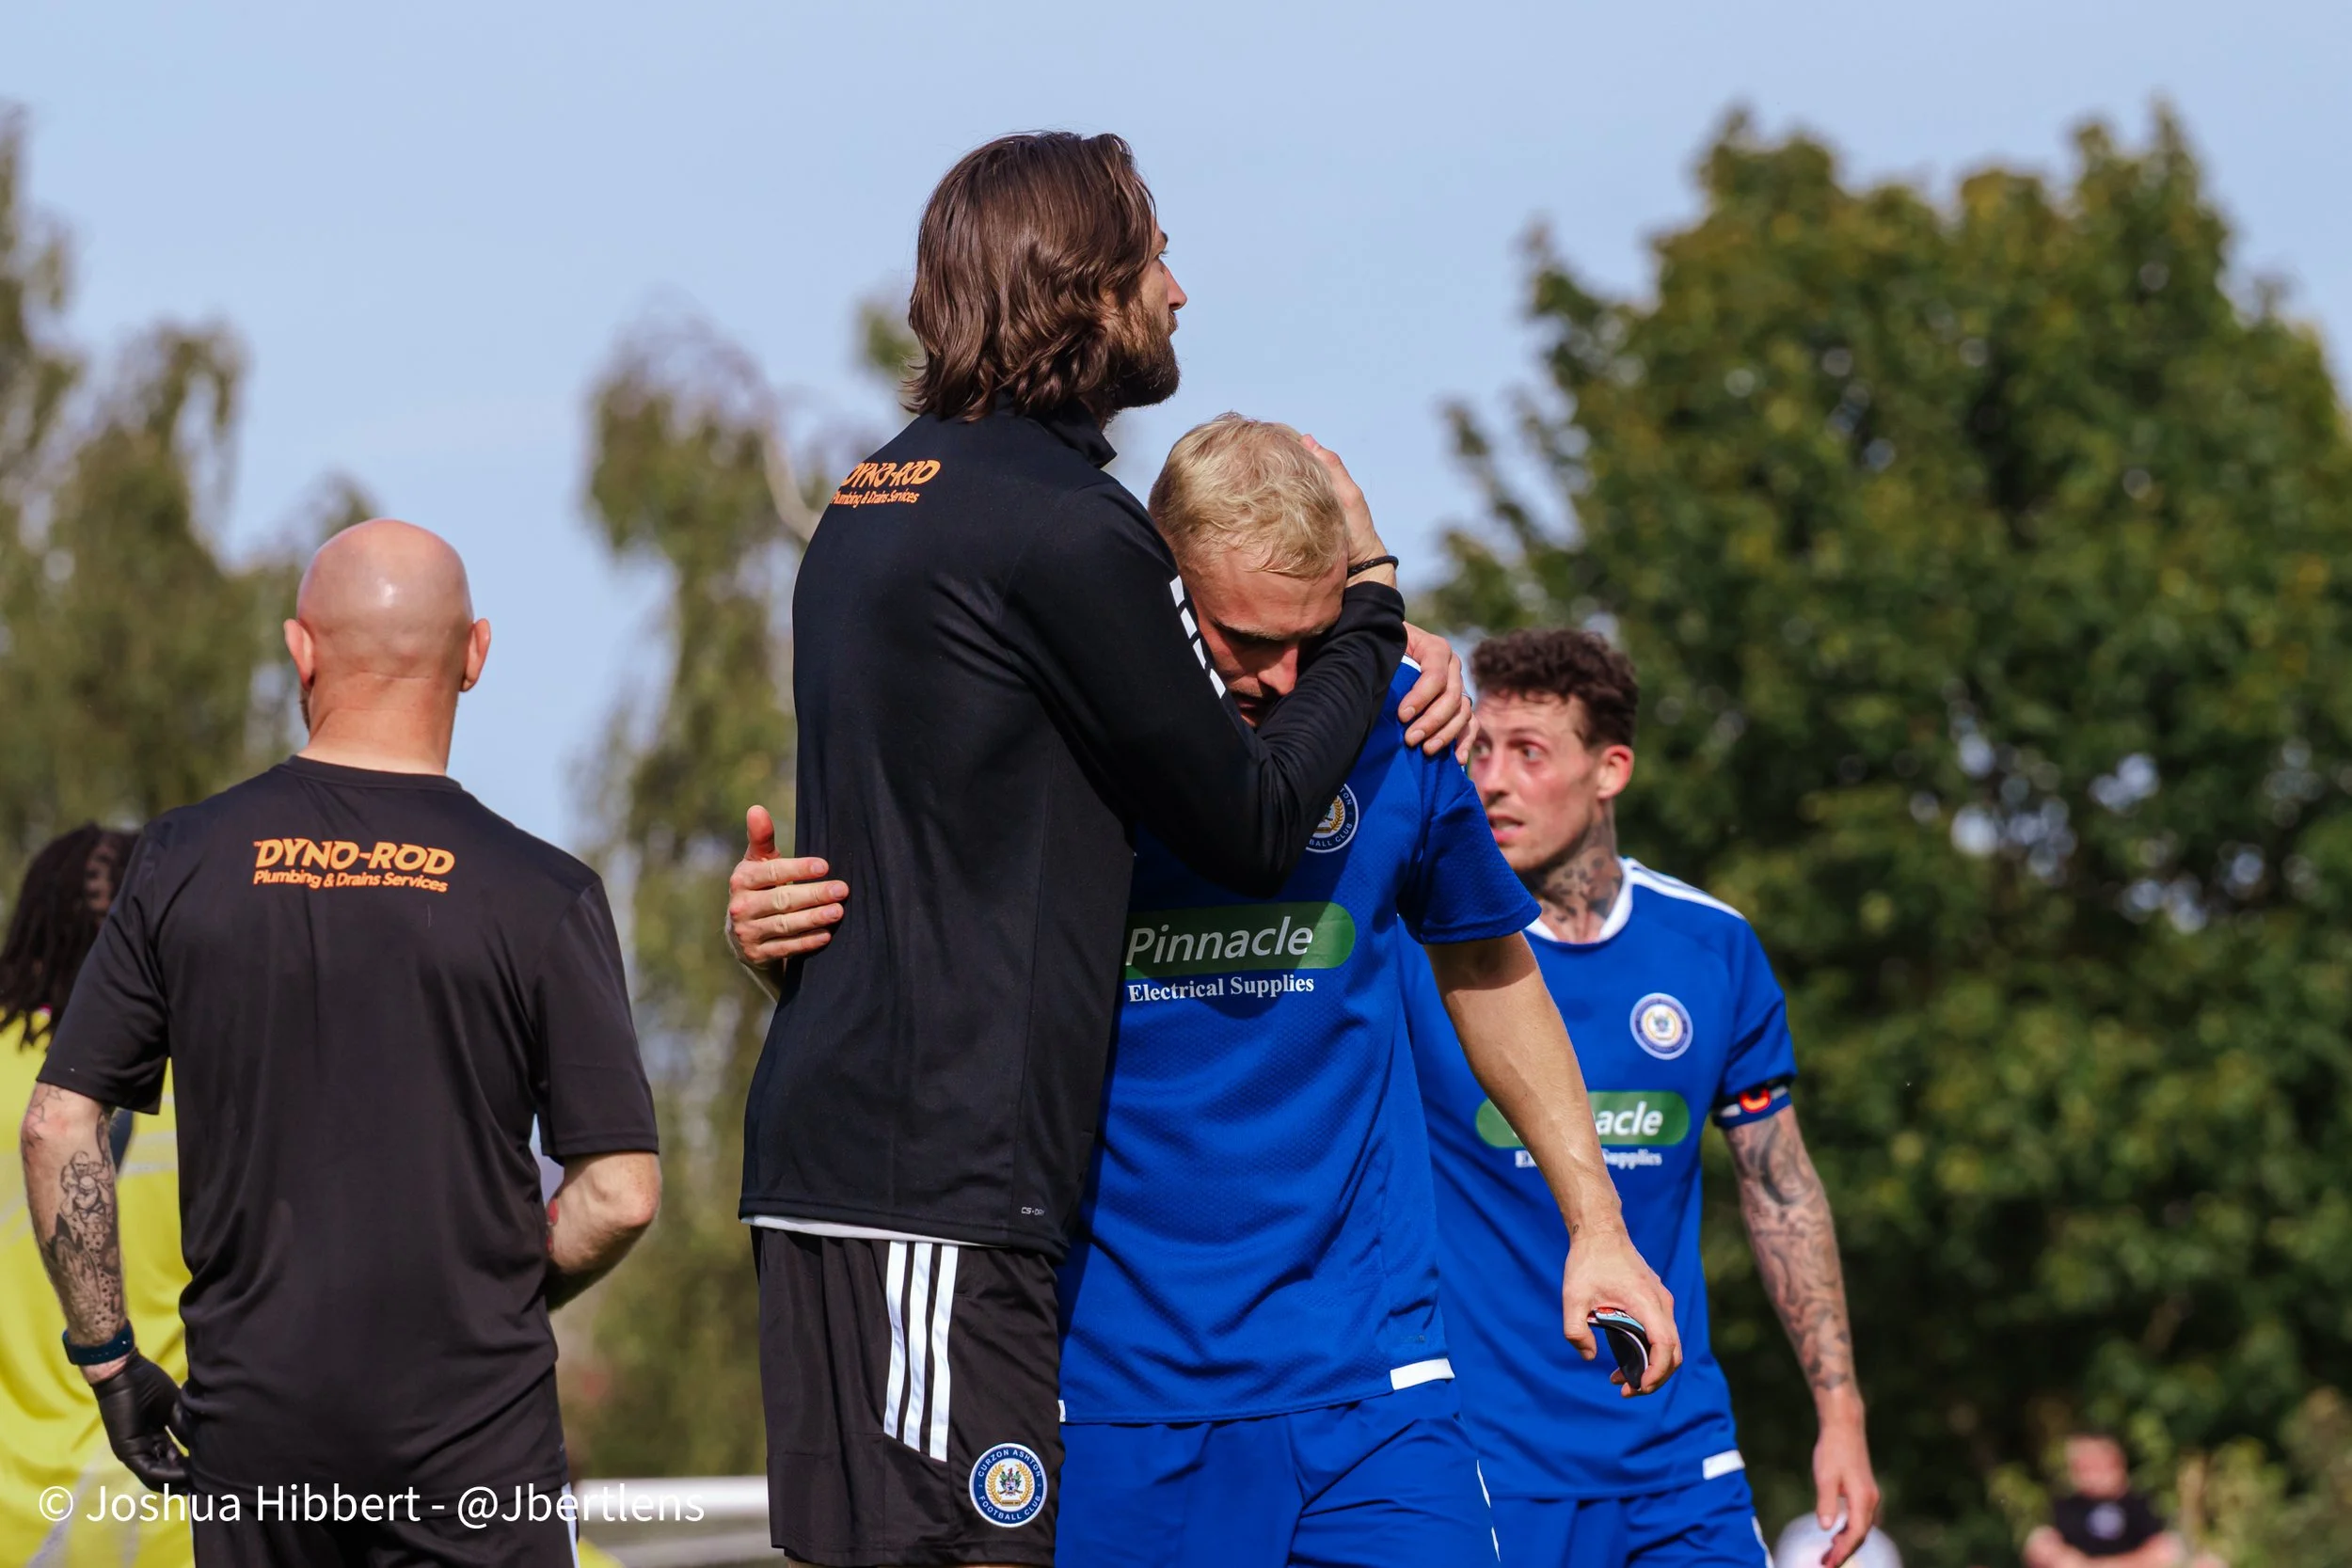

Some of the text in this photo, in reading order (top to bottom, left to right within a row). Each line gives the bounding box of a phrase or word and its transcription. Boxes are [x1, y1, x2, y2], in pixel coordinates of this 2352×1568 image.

[887, 488, 920, 504] Services
[255, 838, 455, 874] DYNO-ROD
[253, 869, 449, 893] Plumbing & Drains Services
[1125, 915, 1314, 966] Pinnacle
[1128, 974, 1315, 1003] Electrical Supplies
[1595, 1101, 1663, 1136] acle
[977, 1449, 1041, 1478] CURZON ASHTON
[978, 1495, 1041, 1521] FOOTBALL CLUB
